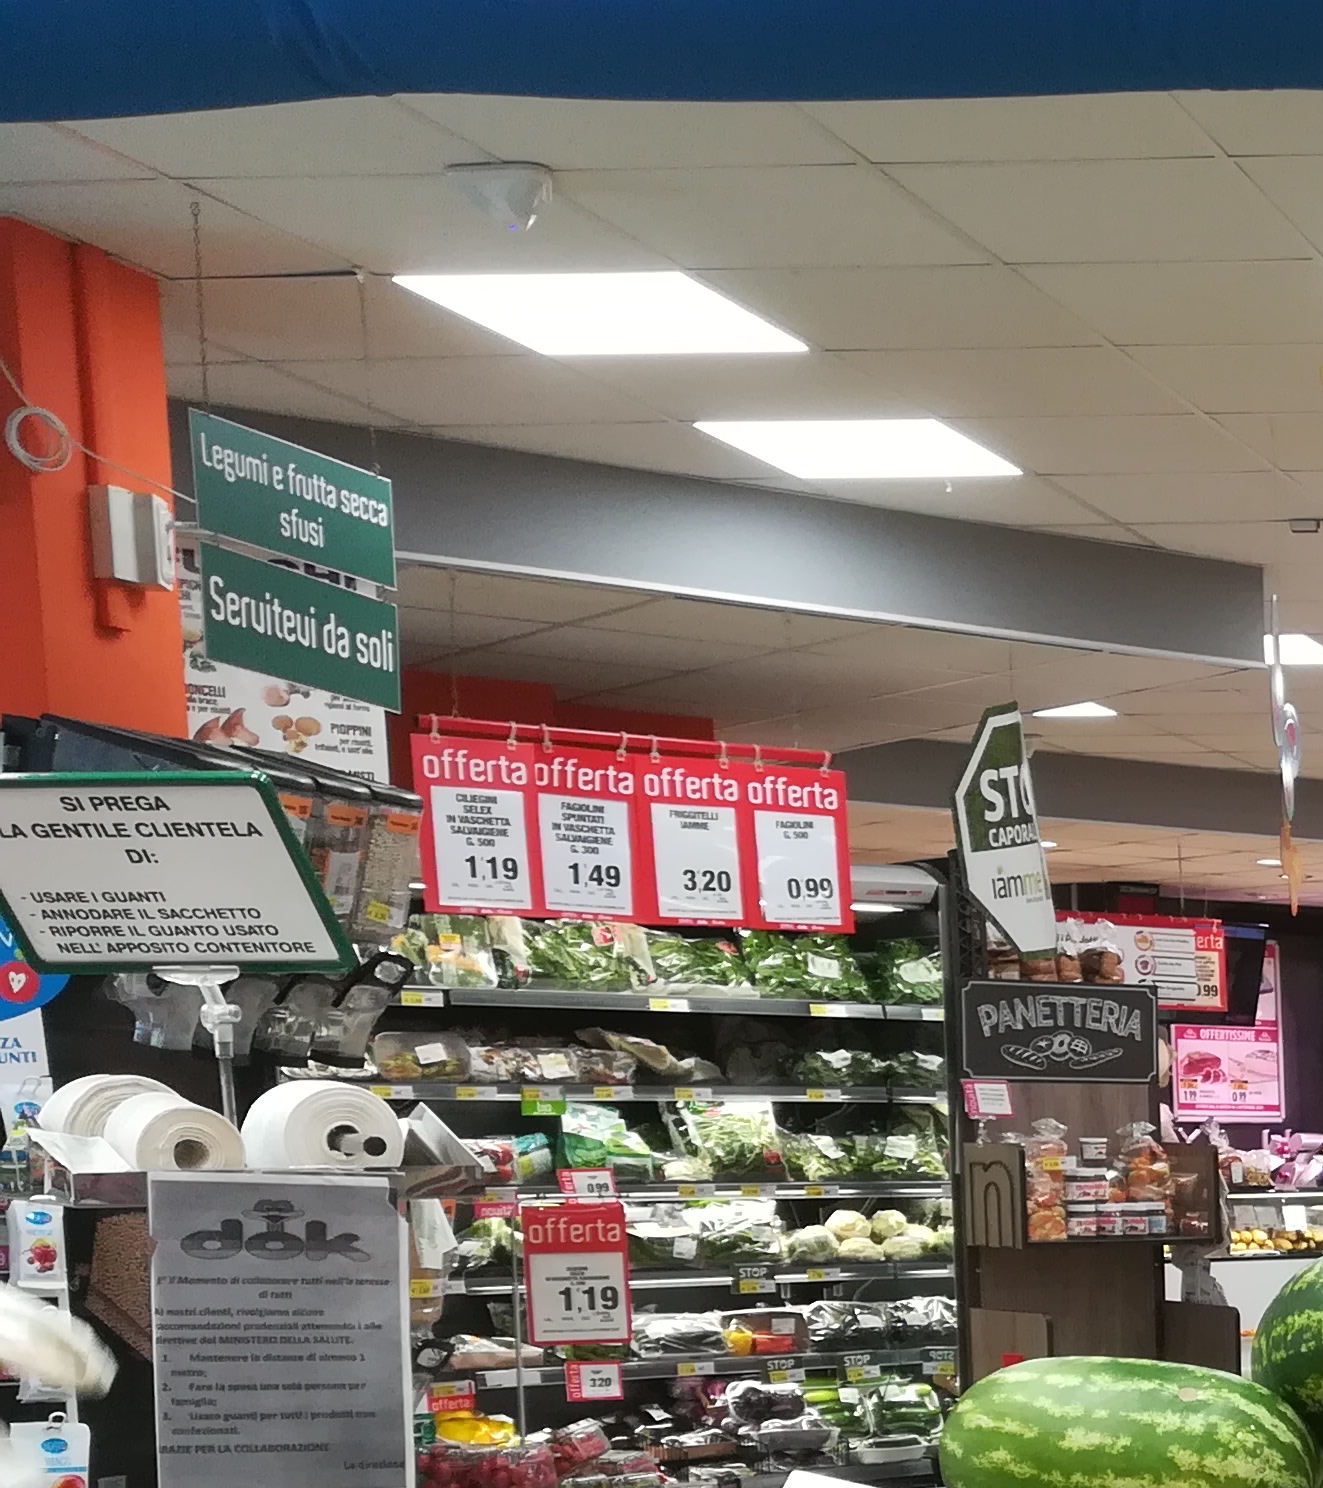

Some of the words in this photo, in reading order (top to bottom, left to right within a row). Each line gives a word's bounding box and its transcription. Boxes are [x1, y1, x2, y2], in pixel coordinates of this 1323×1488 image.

[201, 432, 268, 482] Legumi
[272, 465, 284, 490] e
[288, 463, 336, 509] frutta
[340, 490, 388, 527] secca
[280, 508, 324, 548] sfusi
[323, 613, 350, 658] da
[356, 630, 393, 672] soli
[422, 749, 528, 786] offerta
[534, 757, 635, 795] offerta
[644, 768, 739, 802] offerta
[747, 776, 839, 810] offerta
[60, 795, 85, 812] SI
[91, 795, 171, 812] PREGA
[0, 822, 28, 838] LA
[31, 822, 130, 838] GENTILE
[135, 821, 263, 838] CLIENTELA
[458, 815, 511, 826] VASCHETTA
[125, 848, 159, 864] DI:
[465, 855, 518, 881] 1,19
[568, 862, 621, 887] 1,49
[682, 869, 732, 894] 3,20
[30, 891, 88, 904] USARE
[101, 890, 167, 903] GUANTI
[787, 877, 834, 903] 0,99
[41, 908, 136, 920] ANNODARE
[138, 908, 156, 920] IL
[158, 907, 262, 920] SACCHETTO
[49, 925, 125, 937] RIPORRE
[128, 925, 144, 937] IL
[148, 925, 219, 937] GUANTO
[225, 924, 279, 937] USATO
[106, 941, 194, 954] APPOSITO
[197, 941, 316, 954] CONTENITORE
[977, 995, 1142, 1042] PANETTERIA
[1199, 1028, 1256, 1042] OFFERTISSIME
[528, 1217, 622, 1244] offerta
[738, 1267, 768, 1278] STOP
[558, 1285, 620, 1314] 1,19
[766, 1359, 795, 1370] STOP
[844, 1355, 871, 1366] STOP
[432, 1399, 469, 1411] offerta
